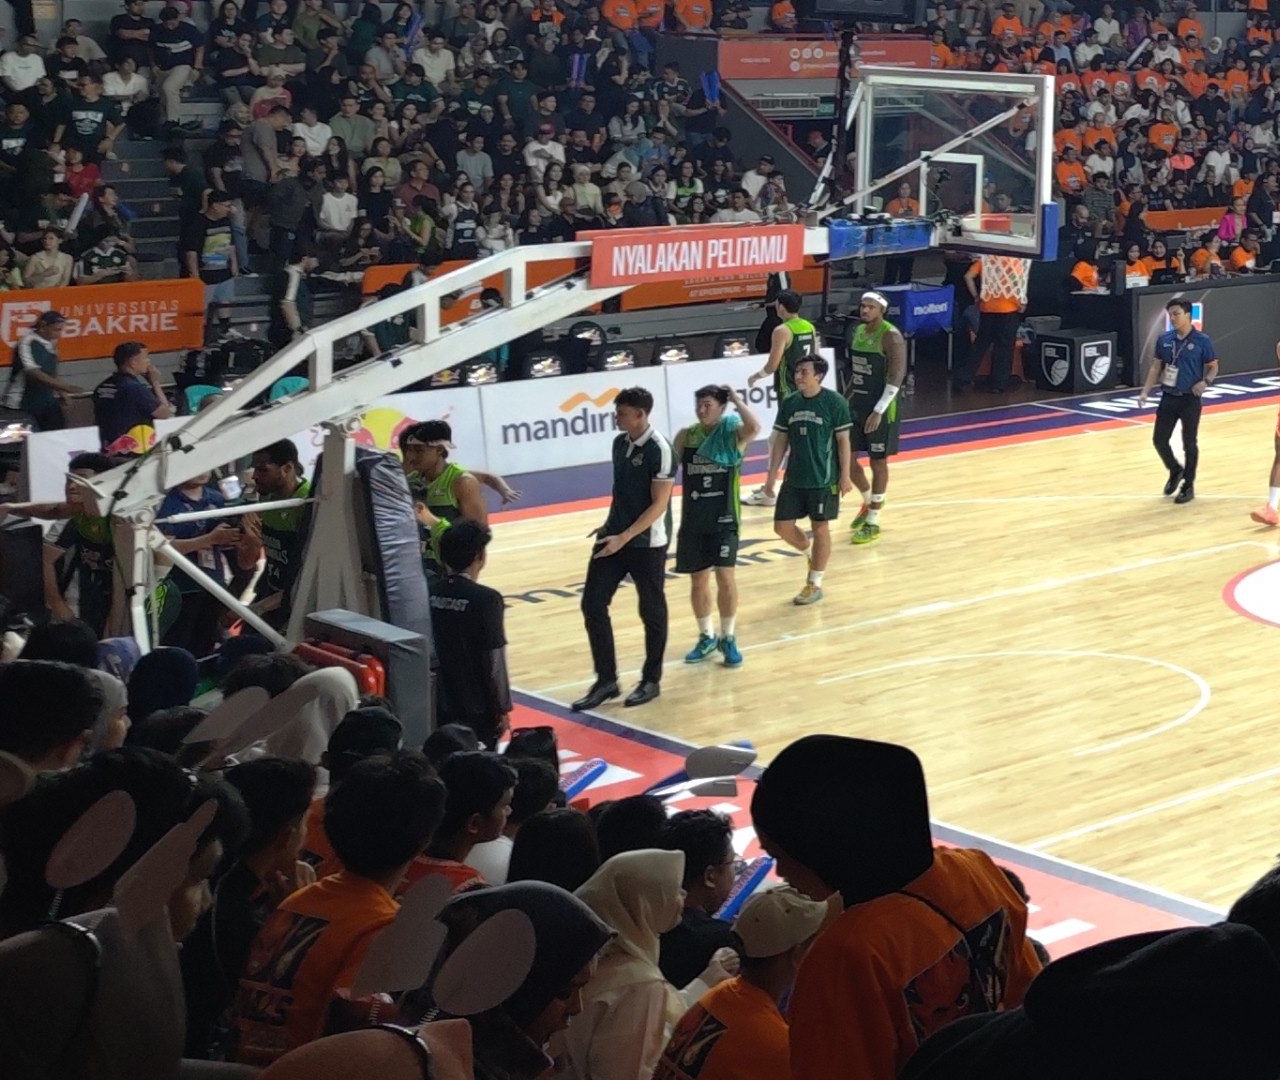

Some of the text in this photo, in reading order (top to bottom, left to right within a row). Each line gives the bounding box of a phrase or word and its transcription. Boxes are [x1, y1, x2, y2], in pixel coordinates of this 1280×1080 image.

[612, 234, 788, 277] NYALAKAN PELITAMU
[60, 299, 180, 317] UNIVERSITAS
[913, 301, 948, 316] molten
[62, 312, 179, 338] BAKRIE
[803, 345, 810, 356] 7
[1044, 347, 1059, 358] IBL
[1085, 346, 1101, 358] IBL
[703, 476, 712, 488] 2
[719, 545, 730, 558] 2
